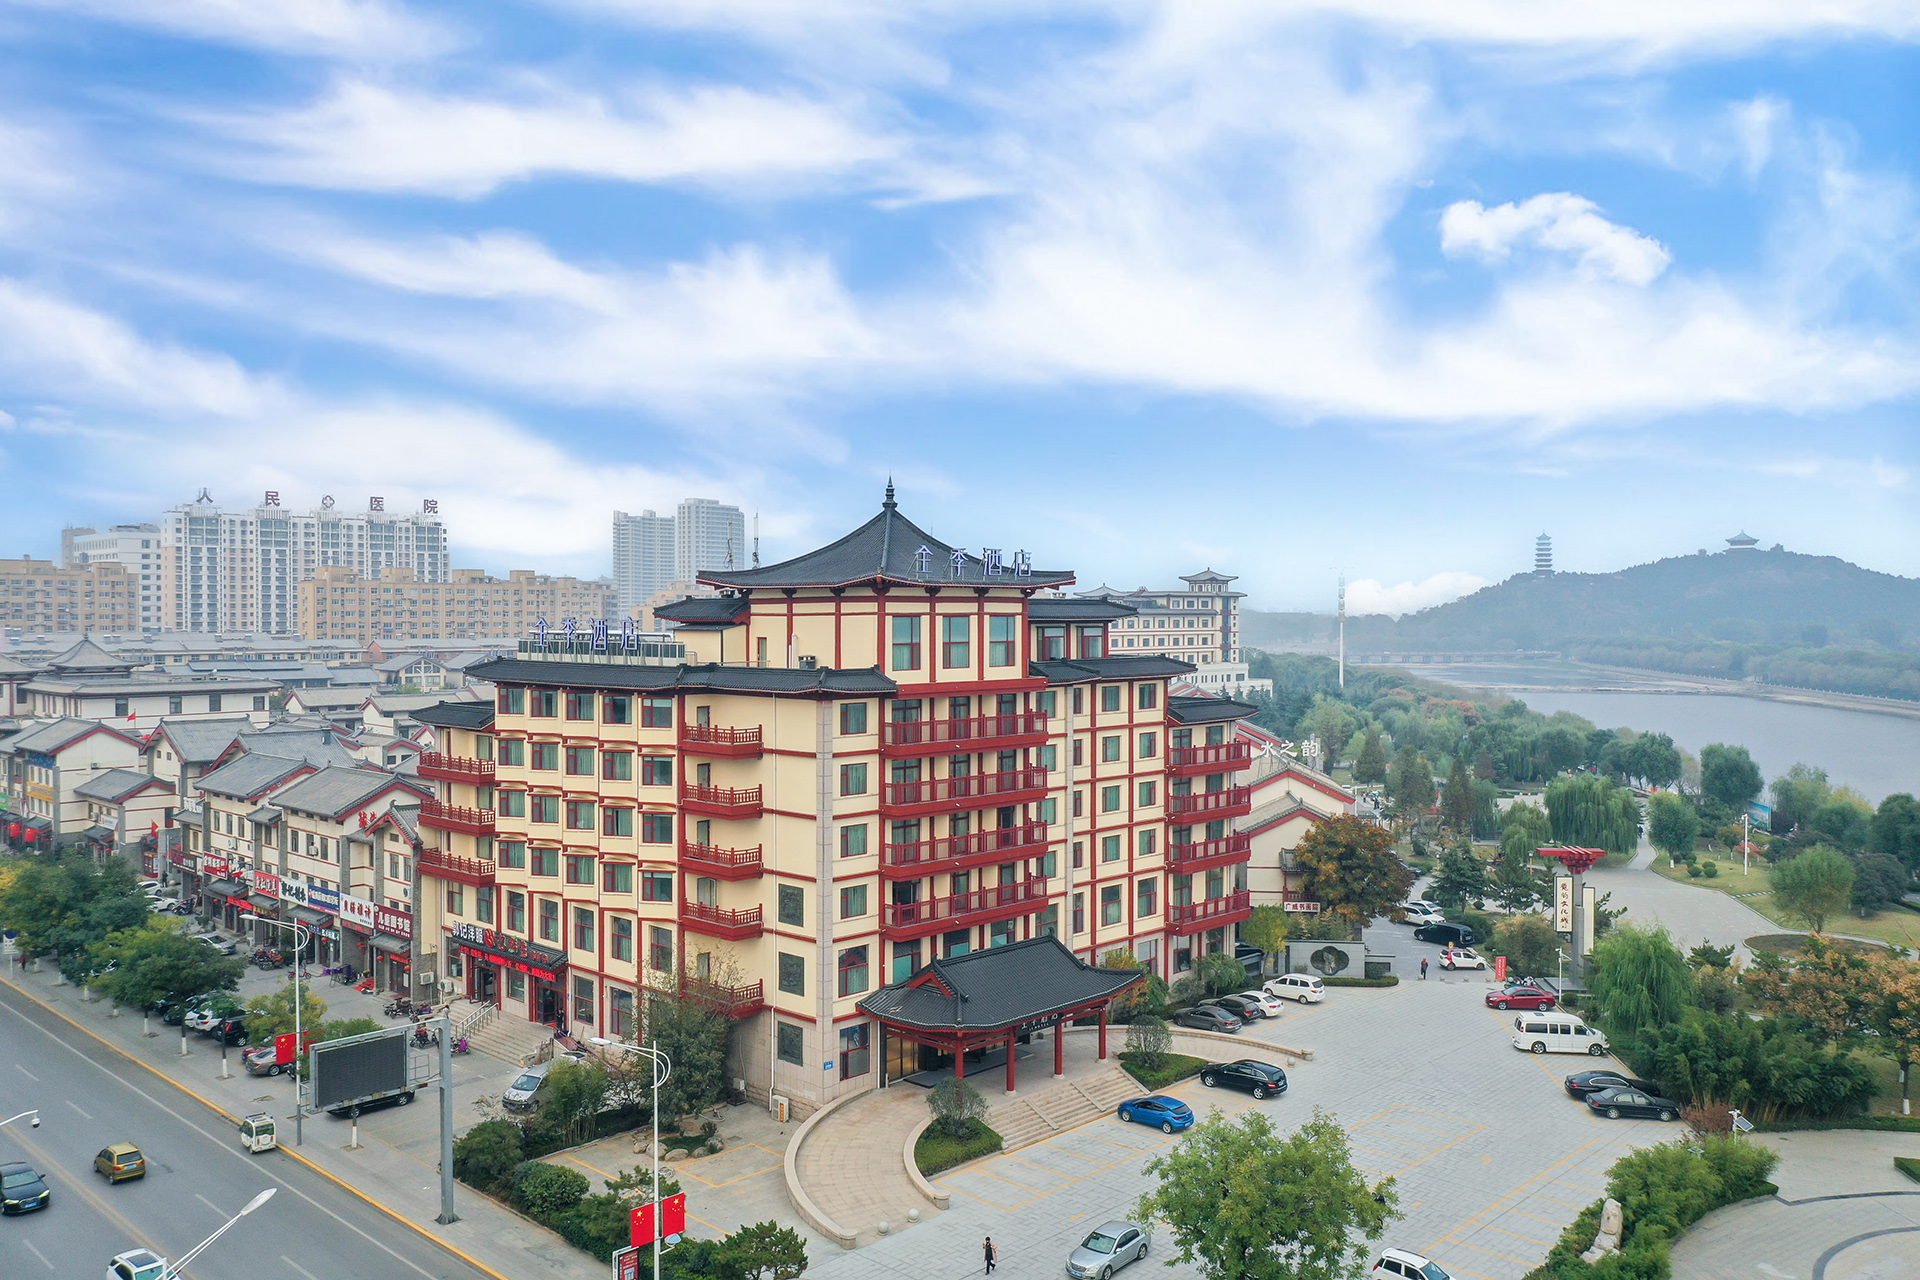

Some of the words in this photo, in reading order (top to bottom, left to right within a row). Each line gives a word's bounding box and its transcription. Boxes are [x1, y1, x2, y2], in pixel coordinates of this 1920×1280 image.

[196, 488, 438, 514] 人民医院
[914, 544, 1031, 577] 全季酒店
[534, 616, 639, 650] 全季酒店
[1259, 740, 1318, 758] 水之韵
